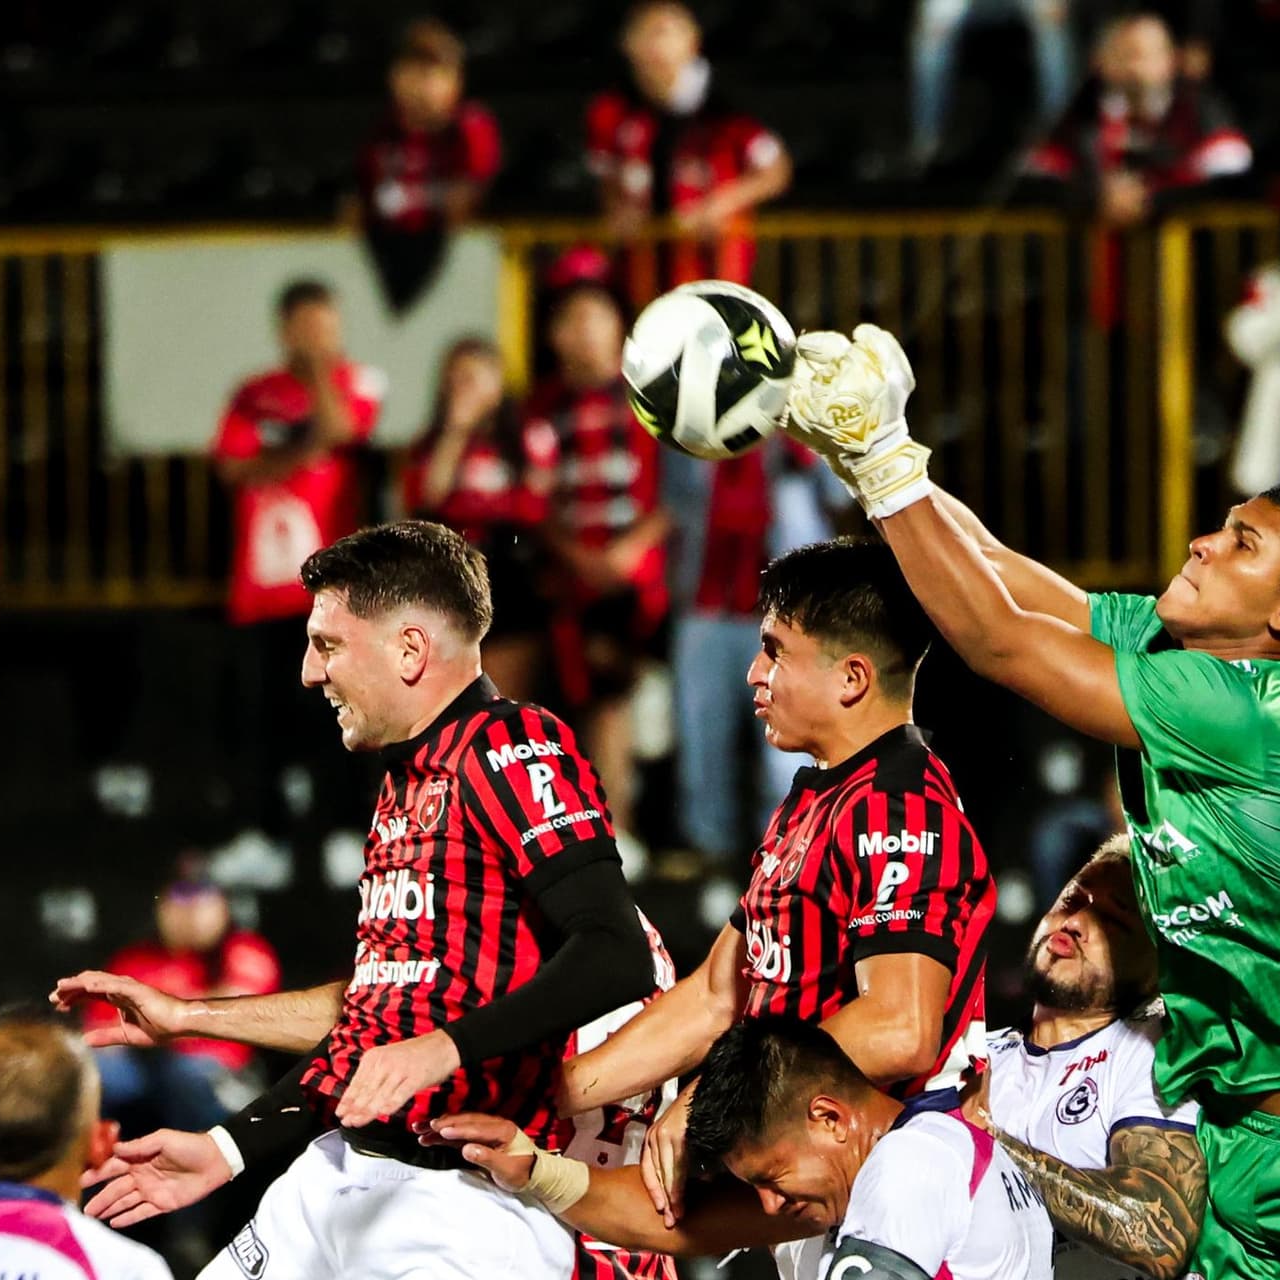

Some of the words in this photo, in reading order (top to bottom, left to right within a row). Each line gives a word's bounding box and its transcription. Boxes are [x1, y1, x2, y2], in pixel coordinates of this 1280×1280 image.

[858, 829, 936, 858] Mobil
[848, 914, 876, 929] ONES
[747, 919, 792, 984] ölbi
